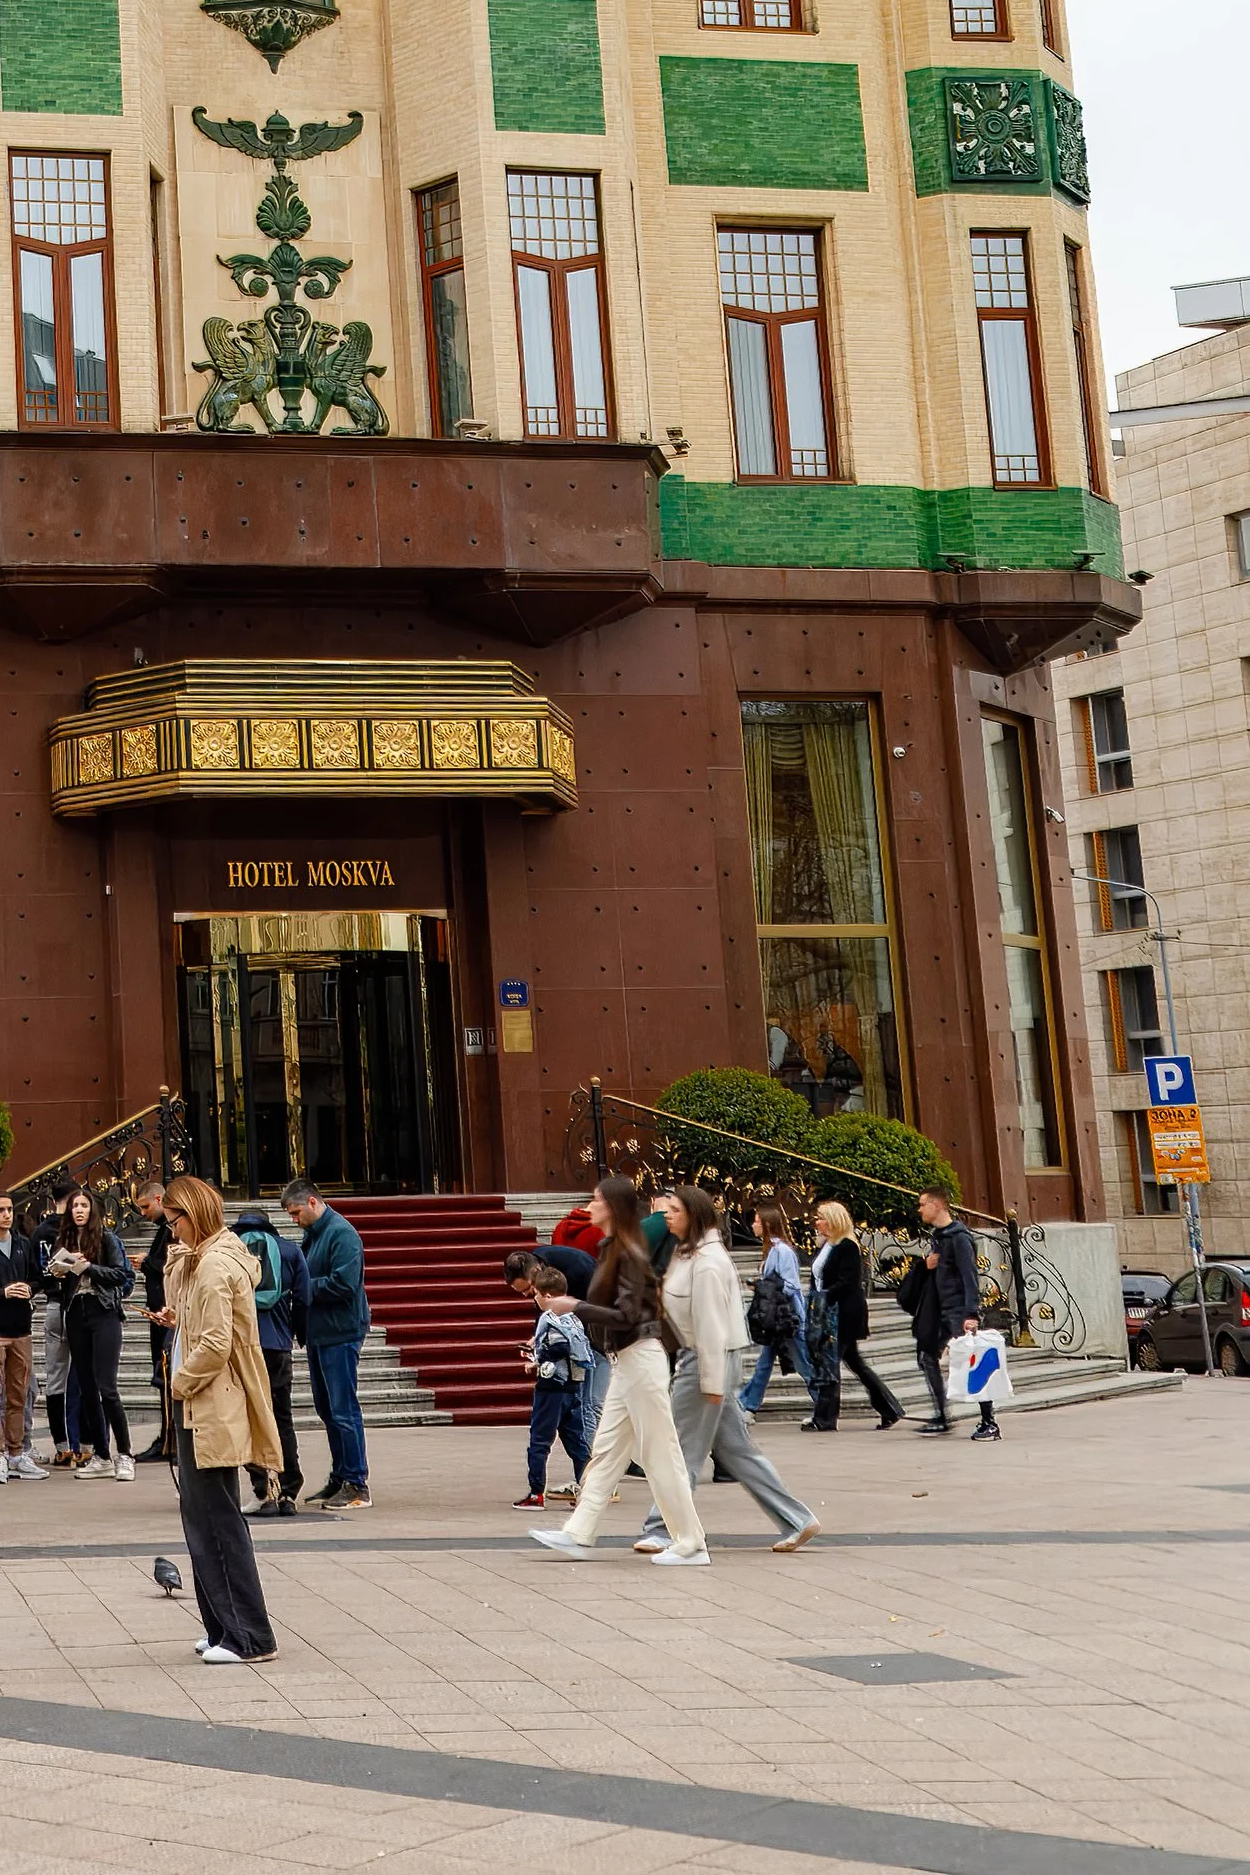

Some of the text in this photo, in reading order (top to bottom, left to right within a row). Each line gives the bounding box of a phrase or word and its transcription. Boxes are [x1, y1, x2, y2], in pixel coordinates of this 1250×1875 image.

[227, 860, 396, 888] HOTEL MOSKVA
[1155, 1063, 1184, 1101] P
